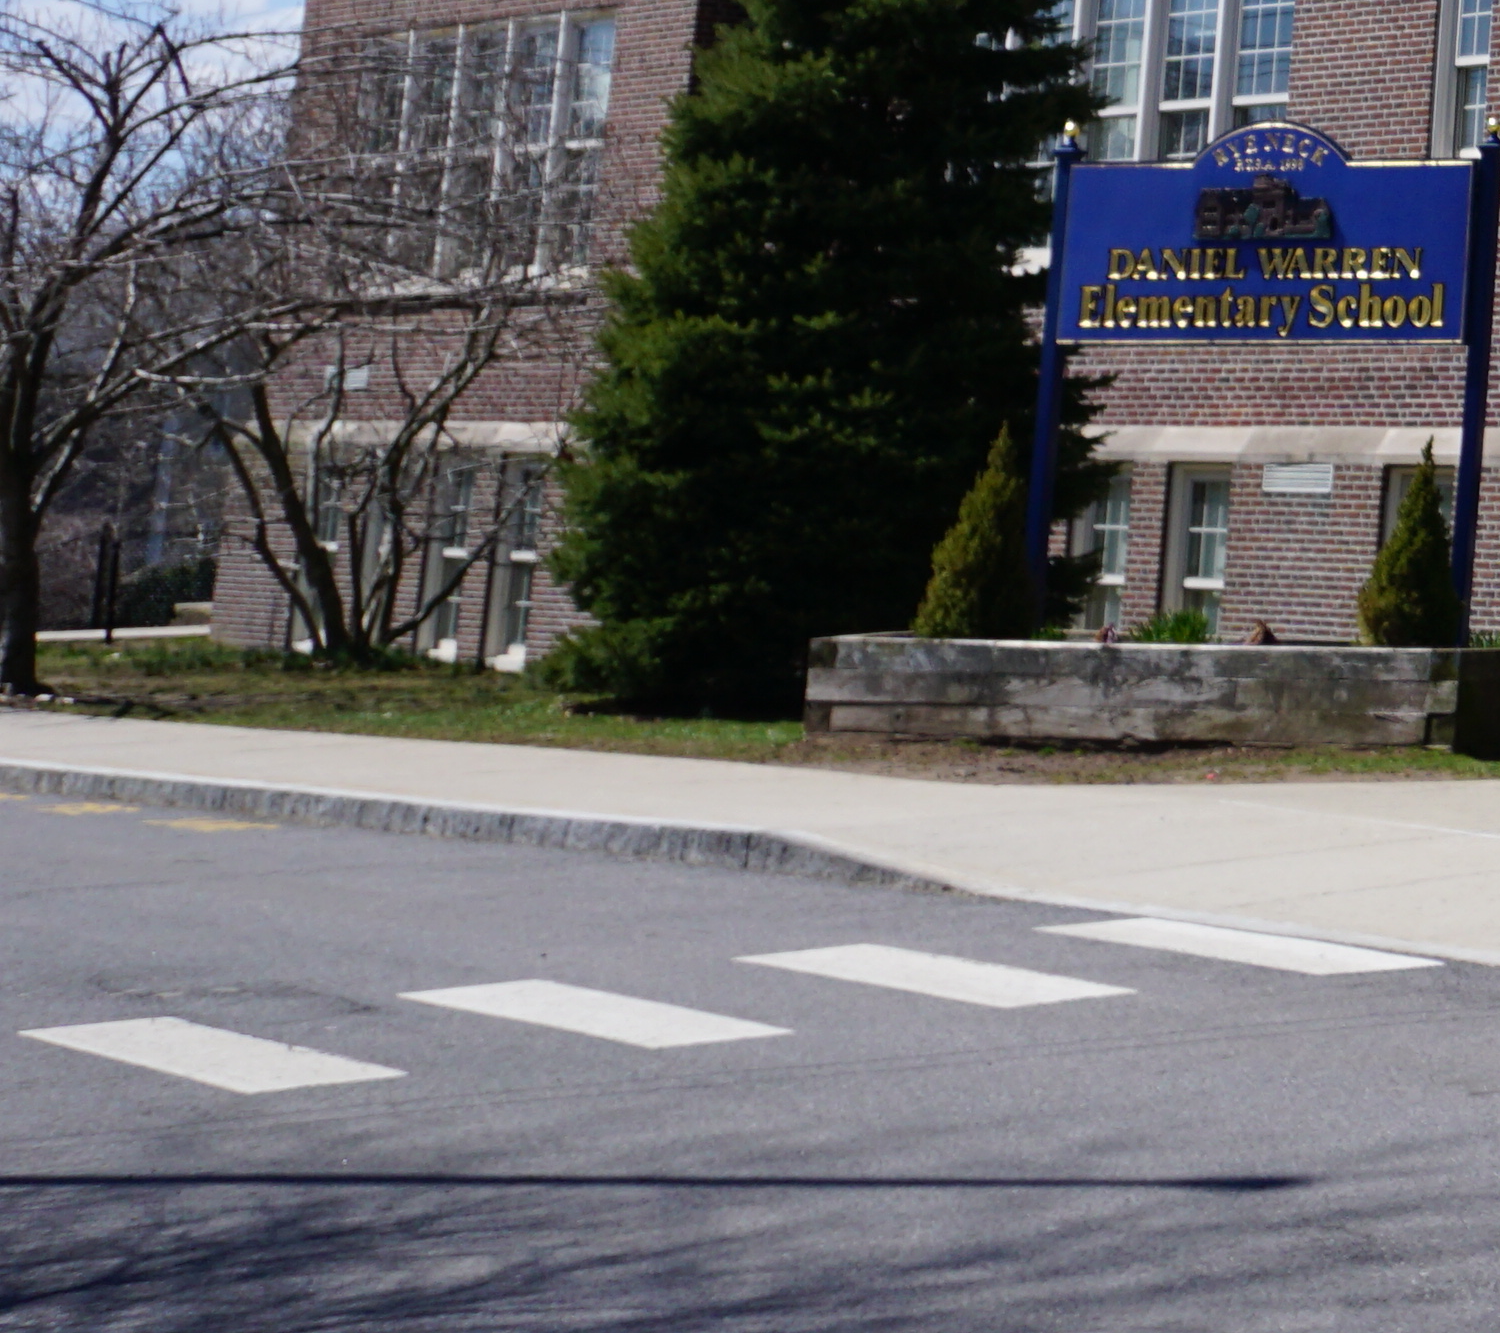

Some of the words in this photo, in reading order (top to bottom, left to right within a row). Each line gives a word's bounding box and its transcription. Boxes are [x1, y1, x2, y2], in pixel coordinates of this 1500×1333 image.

[1264, 133, 1329, 167] NECK
[1106, 247, 1245, 280] DANIEL
[1256, 247, 1422, 280] WARREN
[1079, 284, 1301, 337] Elementary
[1307, 283, 1444, 329] School
